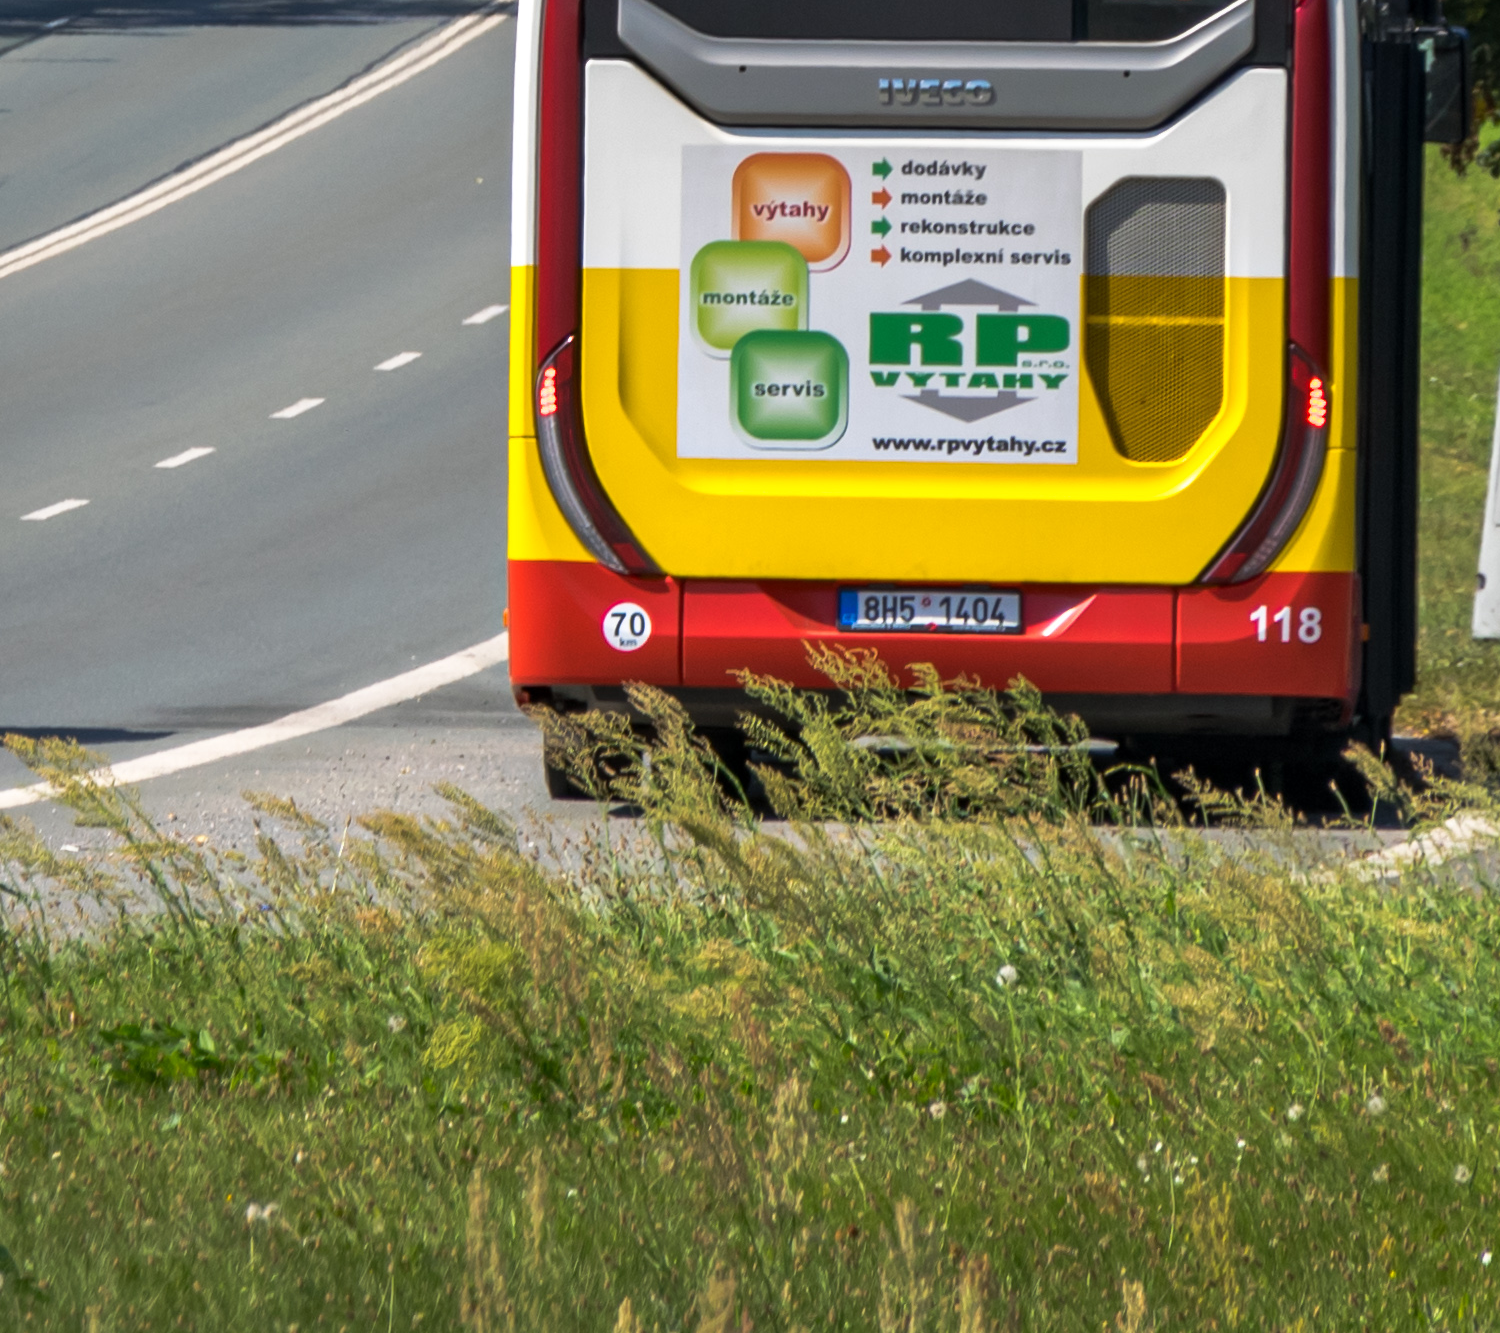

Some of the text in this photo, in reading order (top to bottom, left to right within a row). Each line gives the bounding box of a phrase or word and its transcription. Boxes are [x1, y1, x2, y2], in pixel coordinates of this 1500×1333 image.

[878, 77, 994, 107] IVECO
[900, 159, 987, 181] dodávky
[900, 188, 988, 207] montáže
[753, 199, 830, 222] výtahy
[900, 219, 1036, 237] rekonstrukce
[899, 247, 1072, 267] komplexní servis
[701, 288, 795, 307] montáže
[868, 311, 1072, 369] RP
[753, 380, 826, 399] servis
[871, 434, 1068, 456] www.rpvytahy.cz
[863, 595, 1006, 626] 8H5 1404
[610, 611, 646, 637] 70
[1249, 606, 1323, 644] 118
